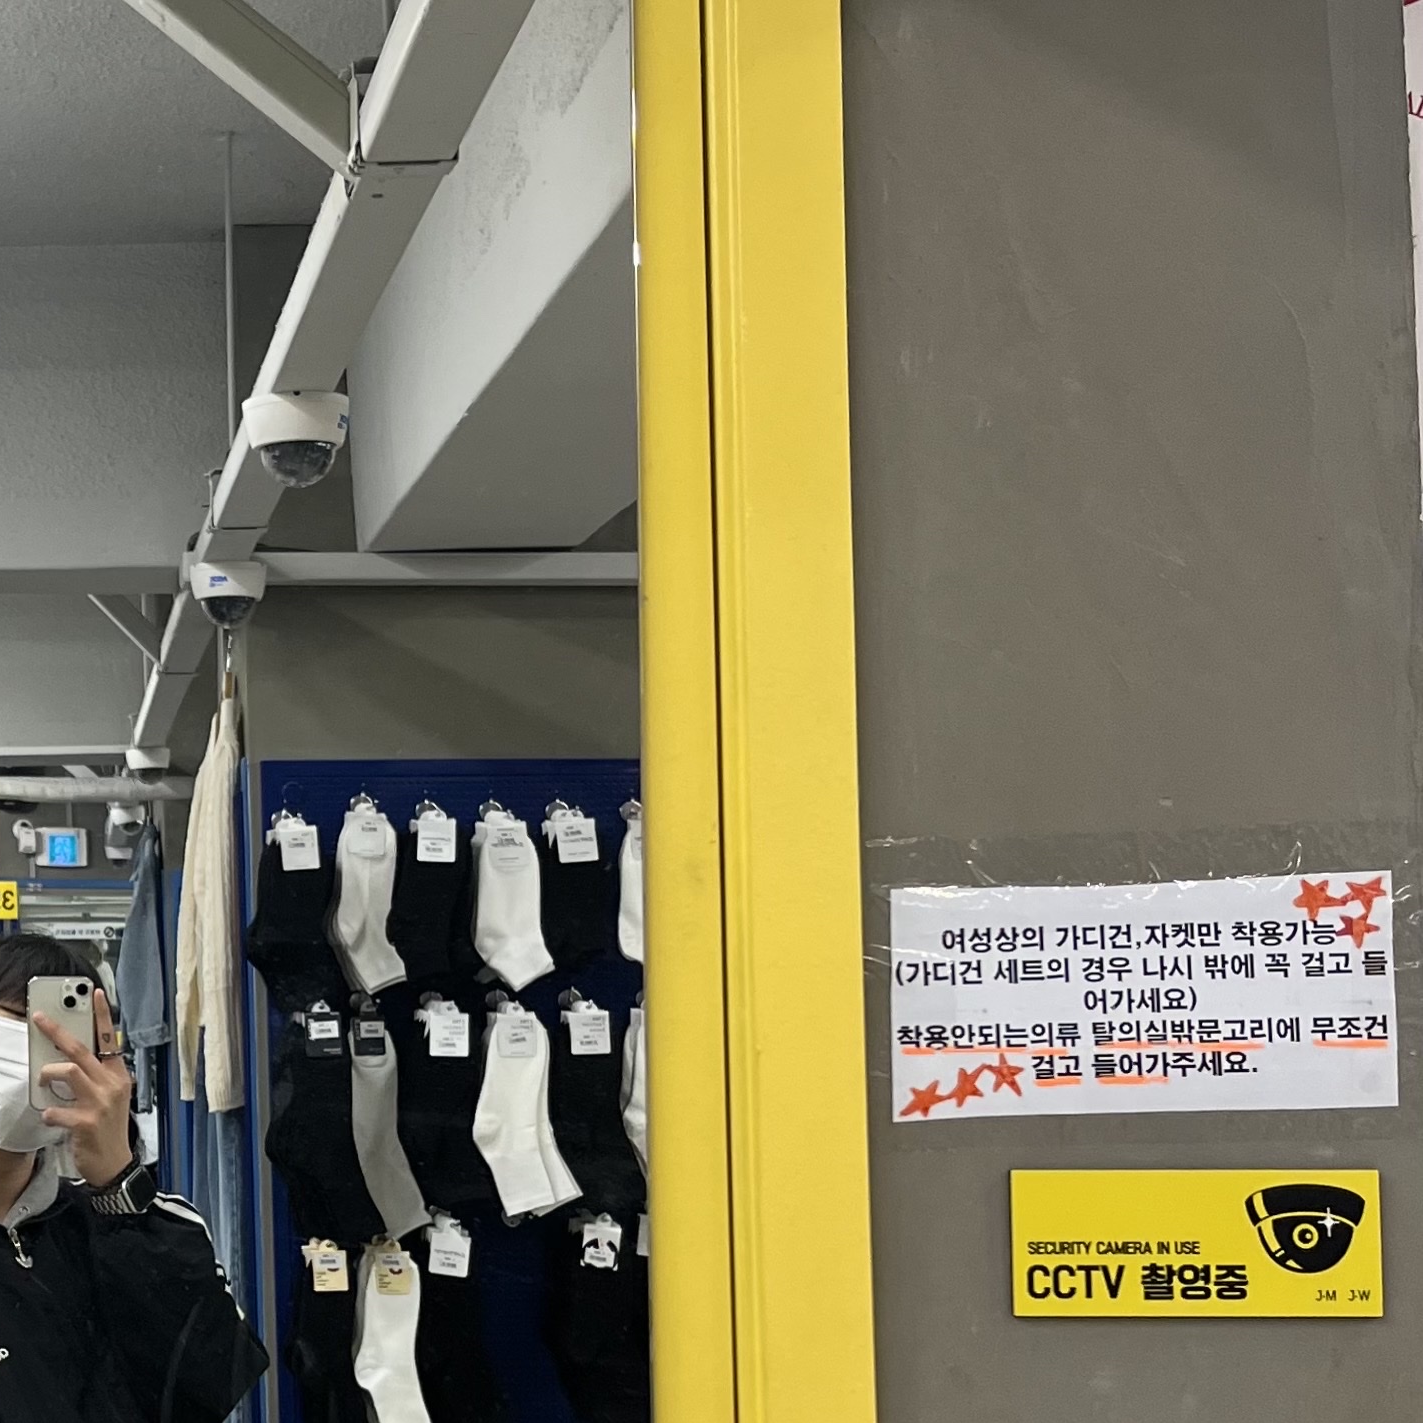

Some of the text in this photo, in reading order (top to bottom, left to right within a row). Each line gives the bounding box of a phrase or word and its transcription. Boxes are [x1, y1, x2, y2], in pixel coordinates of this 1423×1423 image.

[942, 919, 1336, 953] 여성상의 가디건,자켓만 착용가능
[896, 951, 1387, 986] (가디건 세트의 경우 나시 밖에 꼭 걸고 들
[1084, 987, 1196, 1014] 어가세요)
[897, 1015, 1388, 1050] 착용안되는의류 탈의실밖문고리에 무조건
[1032, 1051, 1257, 1079] 걸고 들어가주세요.
[1028, 1241, 1200, 1254] SECURITY CAMERA IN USE
[1027, 1263, 1248, 1300] CCTV 촬영중
